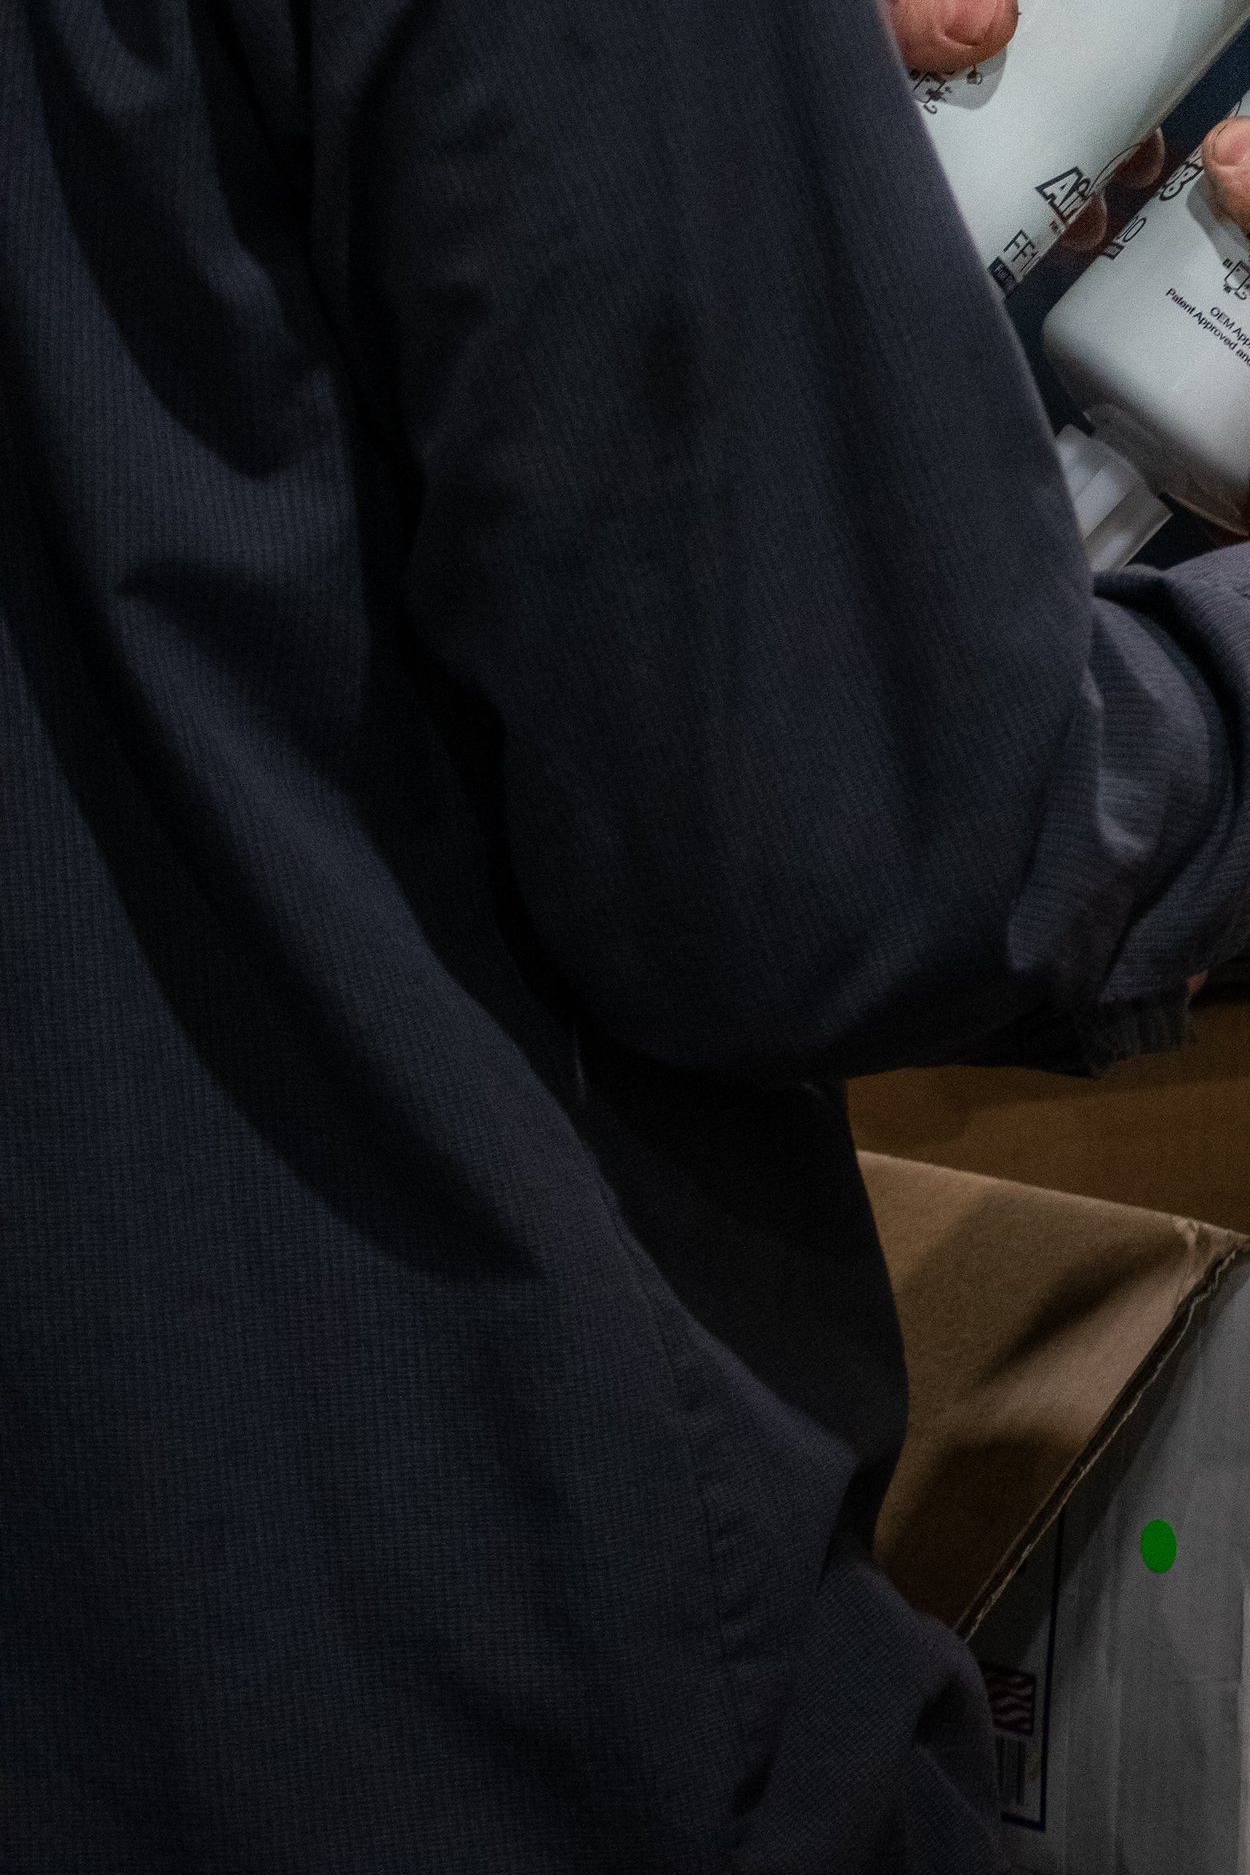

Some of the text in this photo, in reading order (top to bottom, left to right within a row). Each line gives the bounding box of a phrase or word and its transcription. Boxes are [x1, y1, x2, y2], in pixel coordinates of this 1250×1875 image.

[1165, 287, 1196, 315] Patent
[1191, 309, 1238, 351] Approved
[1208, 305, 1235, 330] OEM
